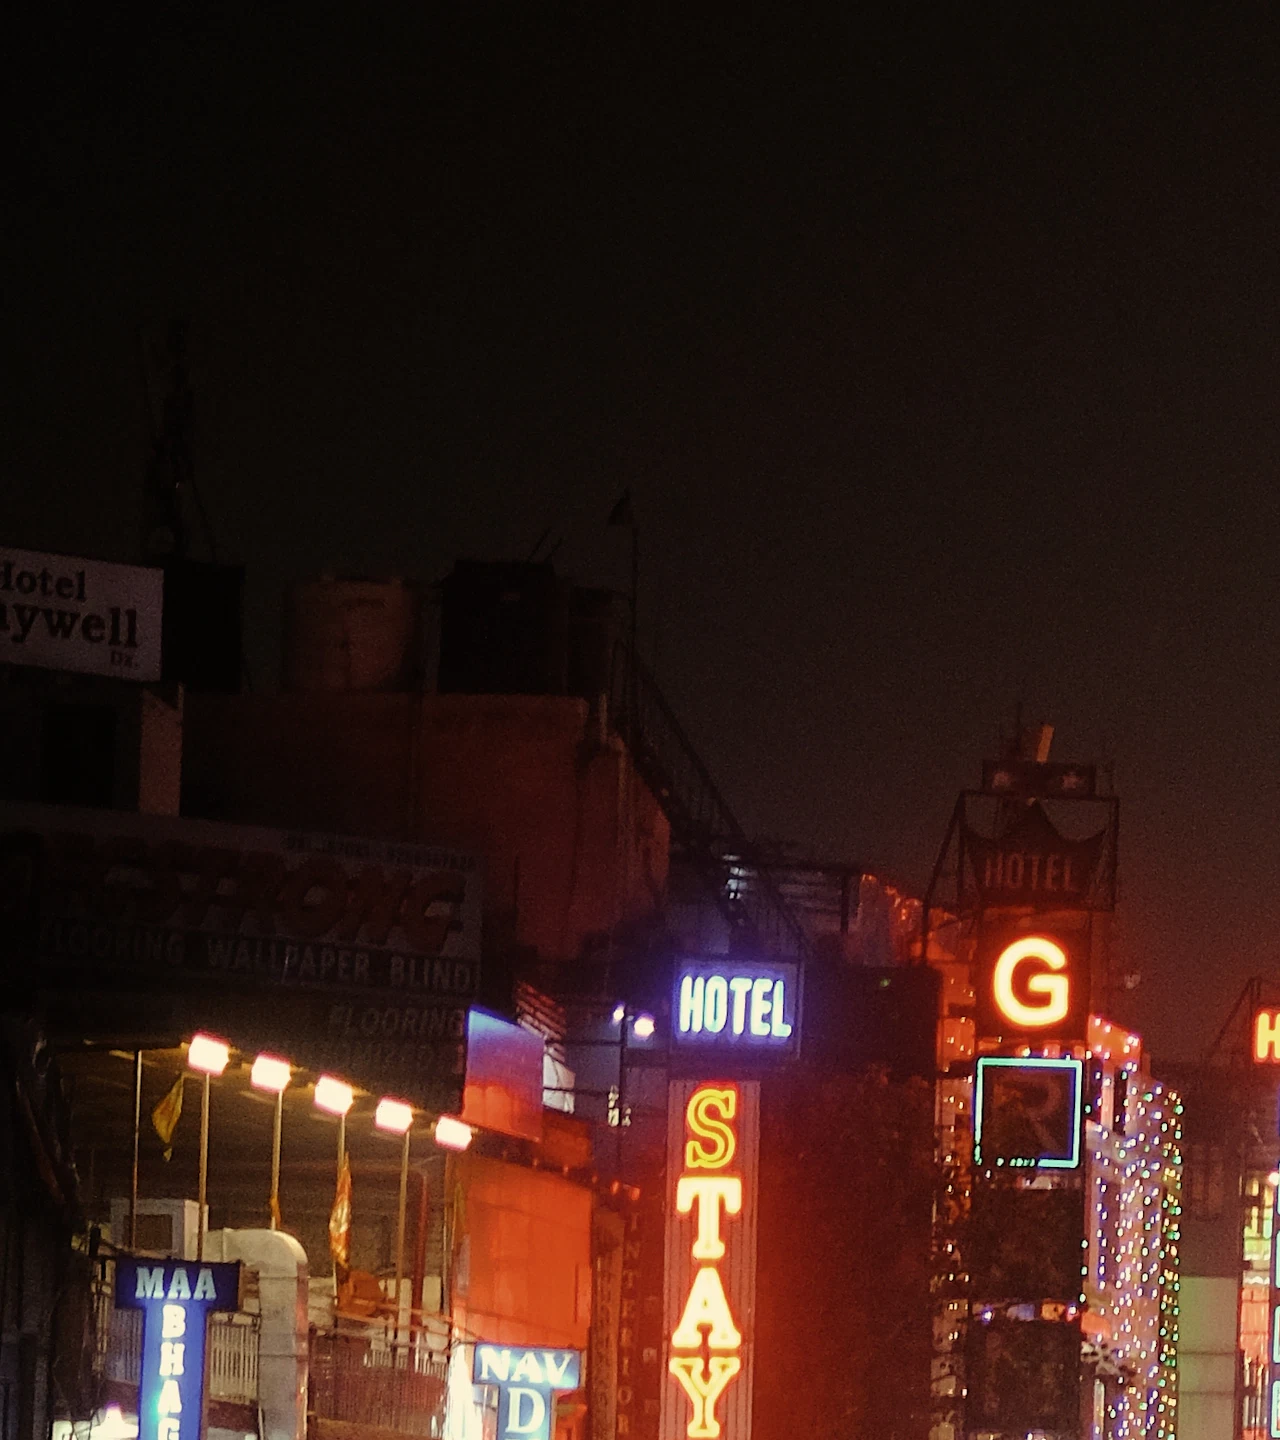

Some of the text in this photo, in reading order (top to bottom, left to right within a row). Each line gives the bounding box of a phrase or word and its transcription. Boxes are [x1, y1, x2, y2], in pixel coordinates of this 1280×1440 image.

[679, 974, 793, 1040] HOTEL
[135, 1266, 217, 1301] MAA
[478, 1350, 572, 1386] NAV
